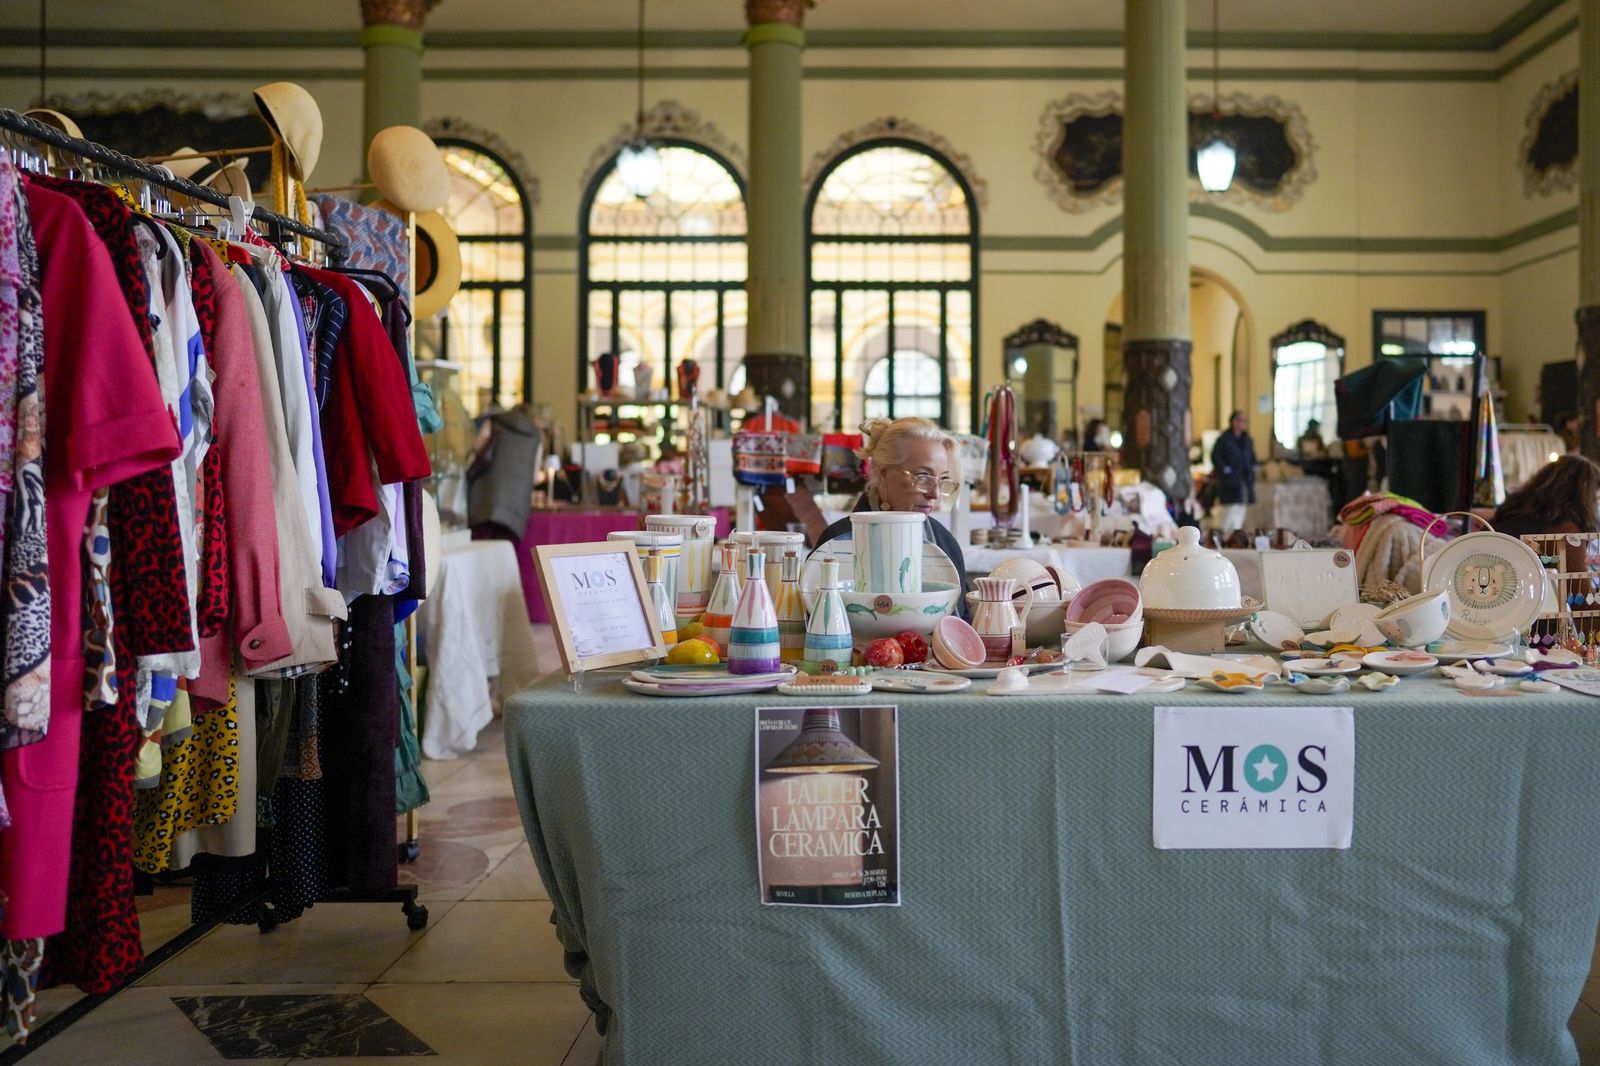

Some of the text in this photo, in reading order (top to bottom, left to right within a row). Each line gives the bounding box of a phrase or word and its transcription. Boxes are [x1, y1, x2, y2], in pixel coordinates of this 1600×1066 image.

[1181, 743, 1328, 794] MOS
[781, 777, 870, 805] TALLER
[1181, 797, 1327, 814] CERÁMICA
